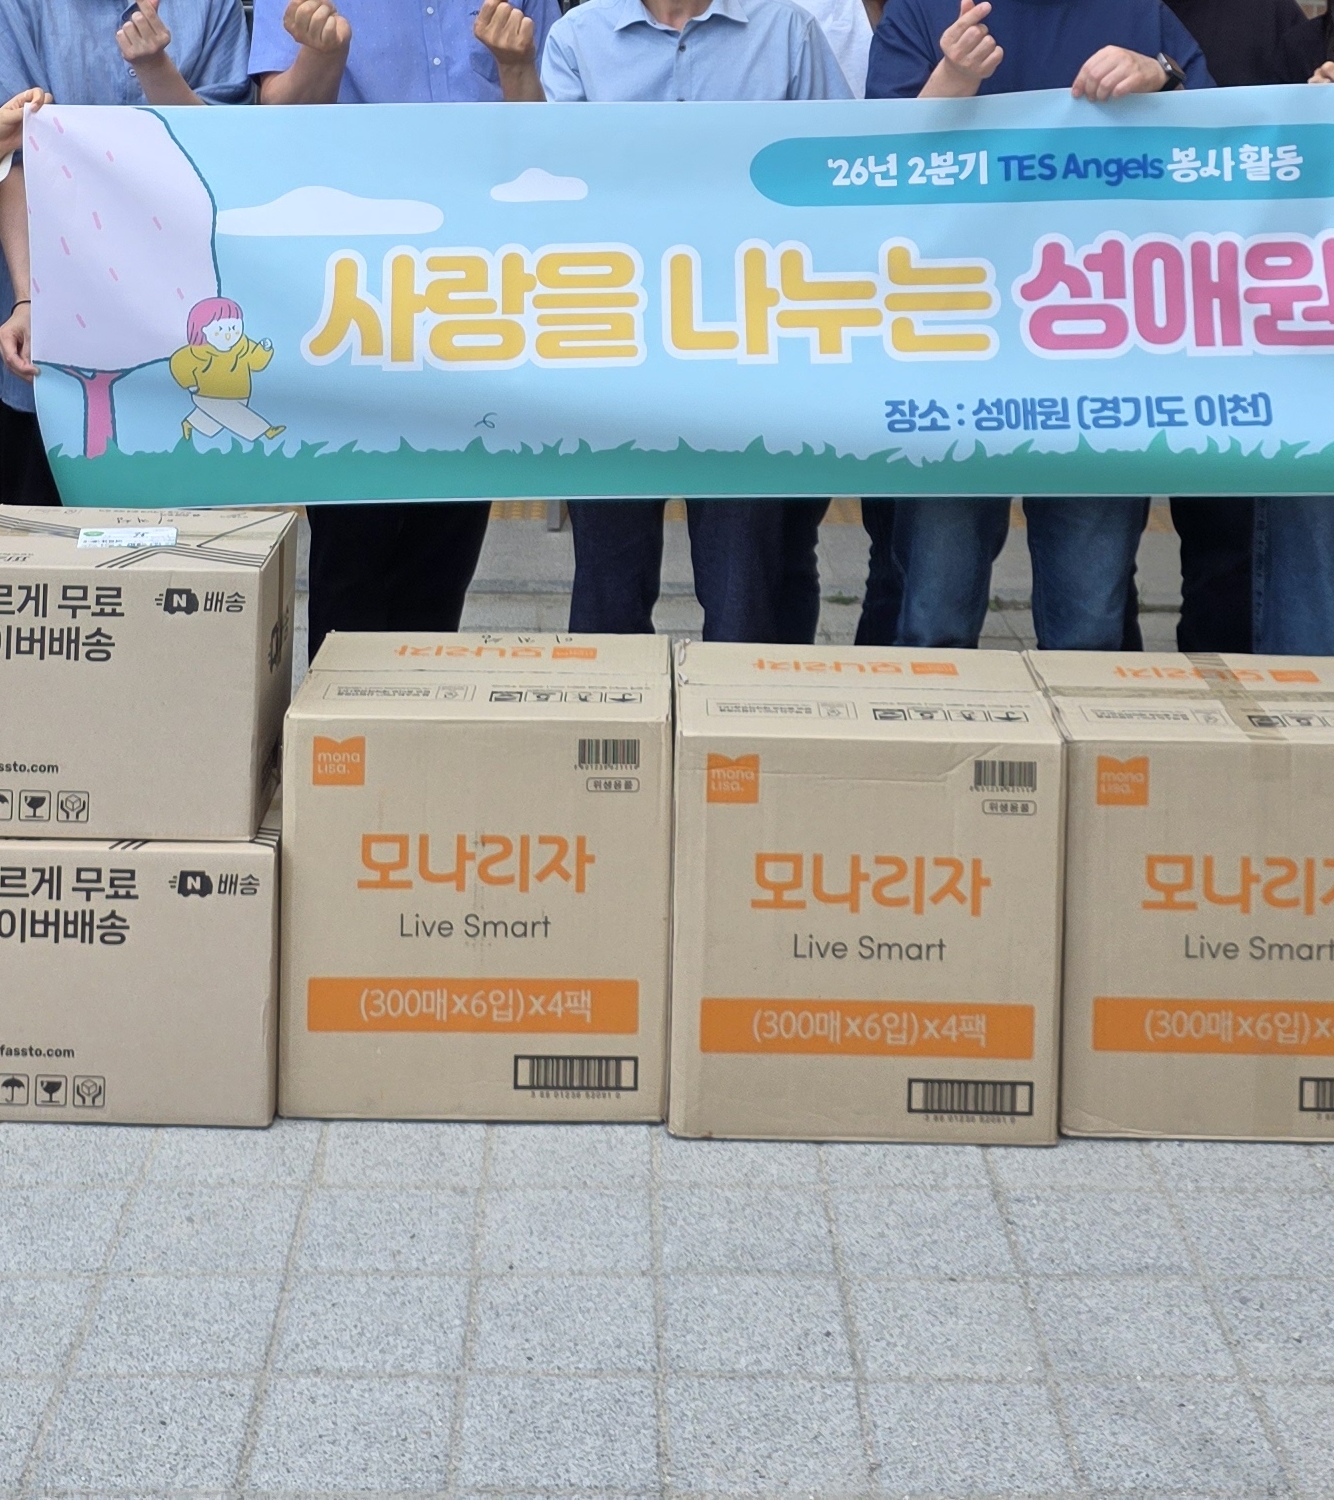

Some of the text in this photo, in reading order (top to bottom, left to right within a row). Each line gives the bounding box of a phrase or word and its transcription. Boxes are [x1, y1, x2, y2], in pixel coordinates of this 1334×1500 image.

[907, 150, 988, 186] 2분기
[997, 153, 1058, 182] TES
[1062, 152, 1164, 187] Angels
[305, 247, 644, 367] 사랑을
[667, 242, 997, 359] 나누는
[972, 396, 1071, 432] 성애원
[57, 584, 125, 619] 무료
[203, 590, 247, 614] 배송
[317, 751, 361, 763] mona
[357, 833, 596, 893] 모나리자
[71, 867, 140, 902] 무료
[218, 872, 261, 897] 배송
[750, 852, 992, 917] 모나리자
[399, 912, 551, 939] Live Smart
[793, 933, 947, 962] Live Smart
[1184, 933, 1240, 961] Live
